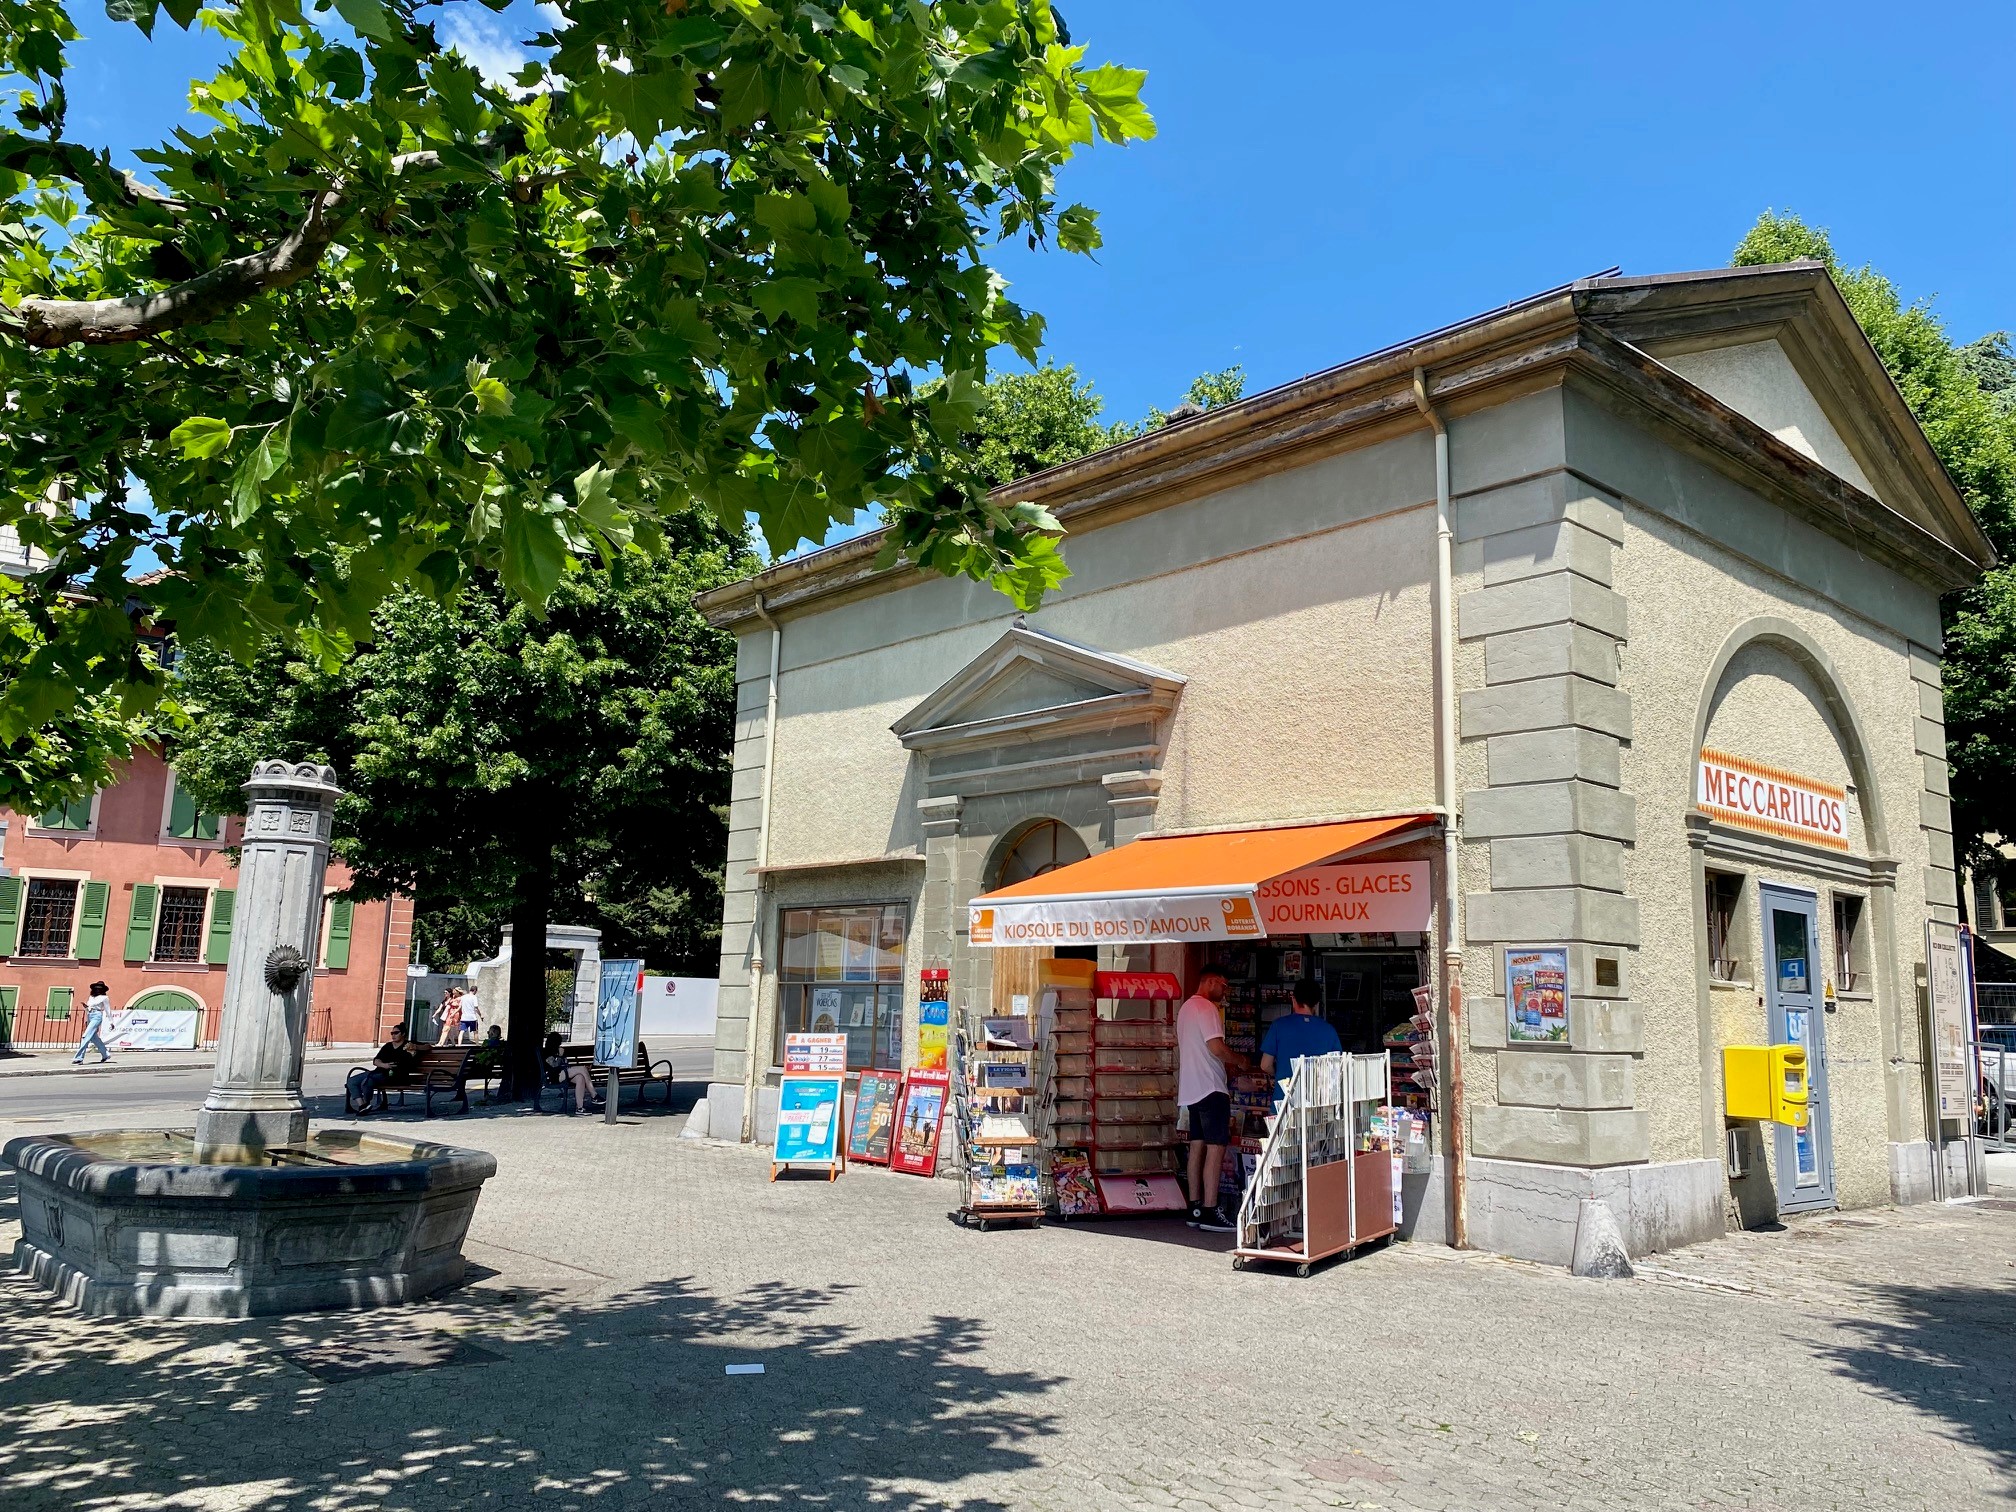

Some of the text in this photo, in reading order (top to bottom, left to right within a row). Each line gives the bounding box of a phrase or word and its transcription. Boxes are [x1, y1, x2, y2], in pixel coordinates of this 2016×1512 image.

[1704, 765, 1841, 834] MECCARILLOS
[1253, 877, 1320, 898] ISSONS
[1336, 873, 1412, 895] GLACES
[1268, 902, 1370, 922] JOURNAUX
[1004, 916, 1212, 939] KIOSQUE DU BOIS D'AMOUR
[1512, 954, 1540, 964] NOUVEAU
[1109, 977, 1174, 996] HARIBO
[820, 1046, 829, 1054] 19
